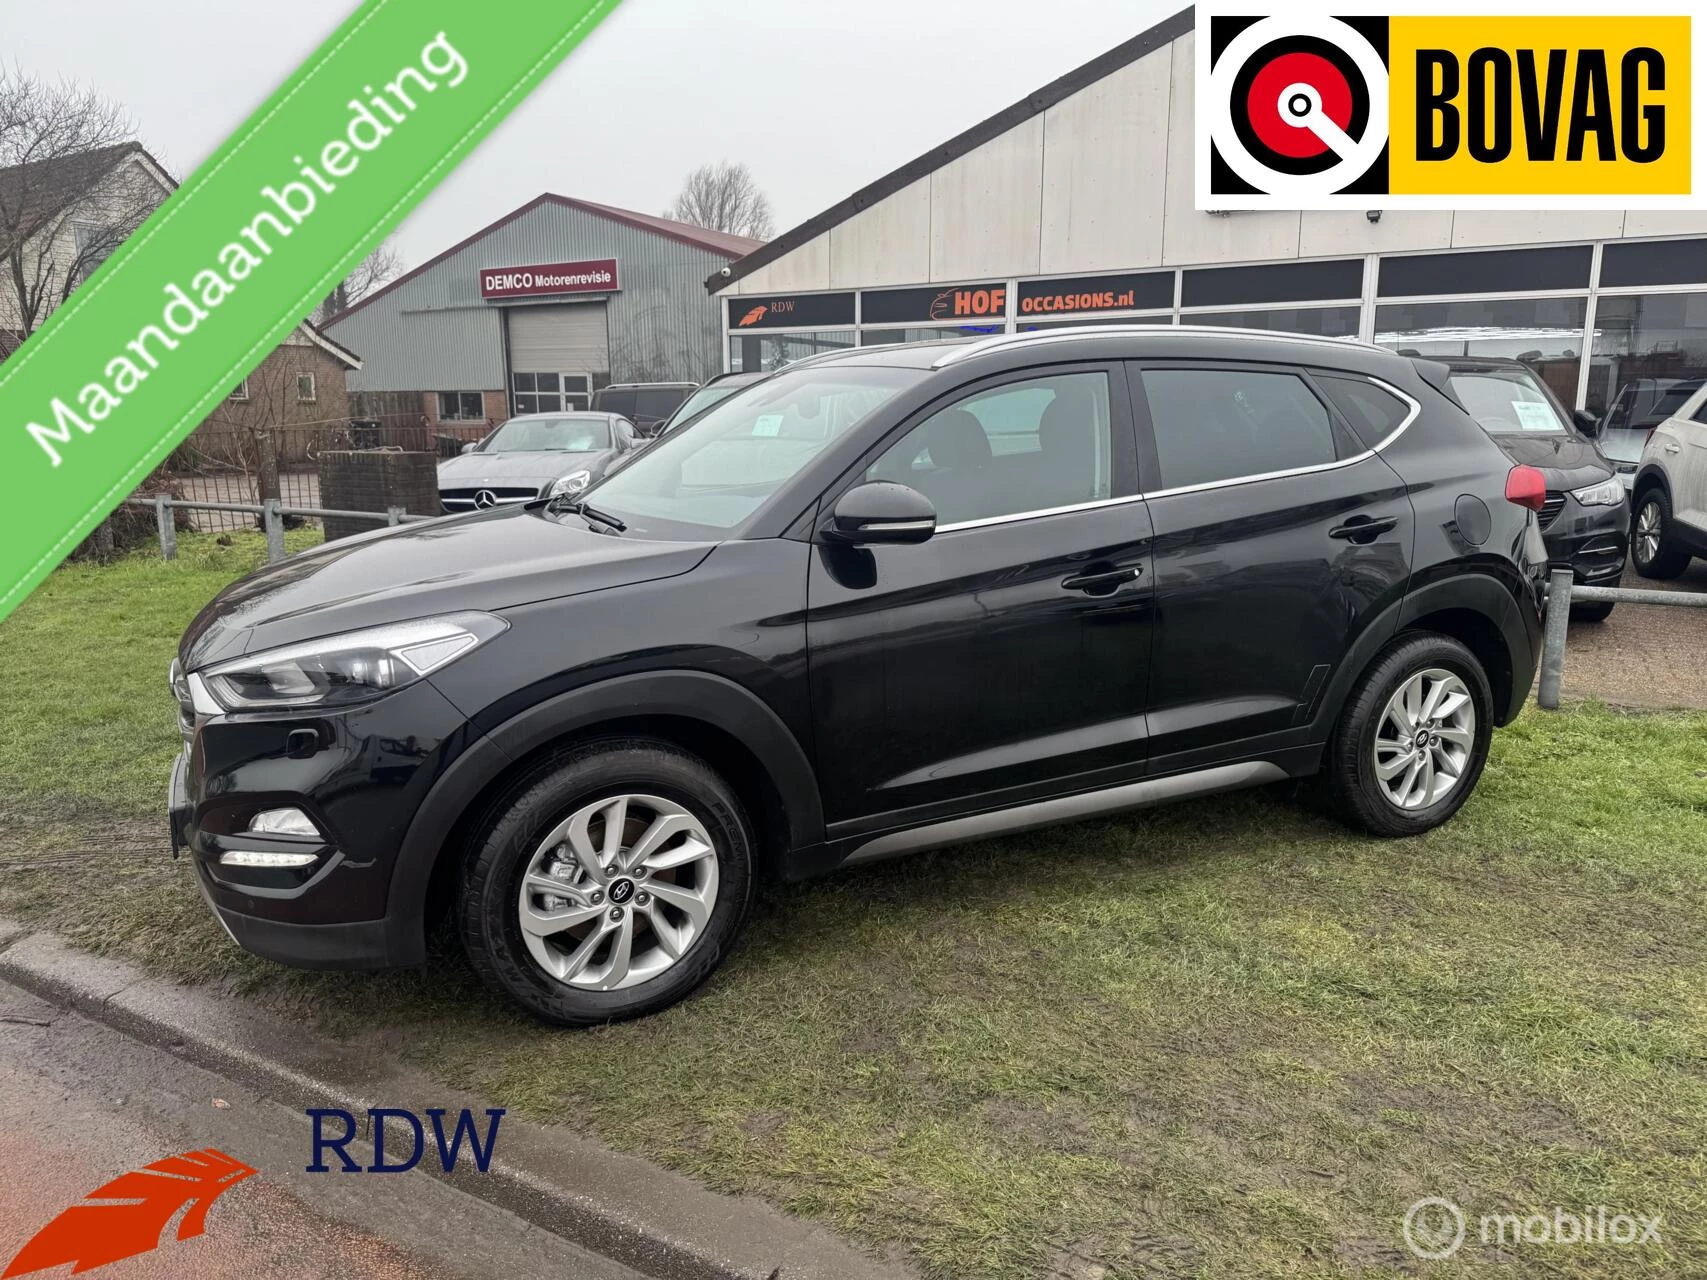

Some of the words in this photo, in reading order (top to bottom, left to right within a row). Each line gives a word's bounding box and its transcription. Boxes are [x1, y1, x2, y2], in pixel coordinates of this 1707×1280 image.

[485, 272, 533, 291] DEMCO
[534, 270, 611, 288] Motorenrevisie
[771, 301, 796, 314] RDW
[954, 288, 1006, 315] HOF
[1021, 289, 1135, 313] OCCASIONS.nl
